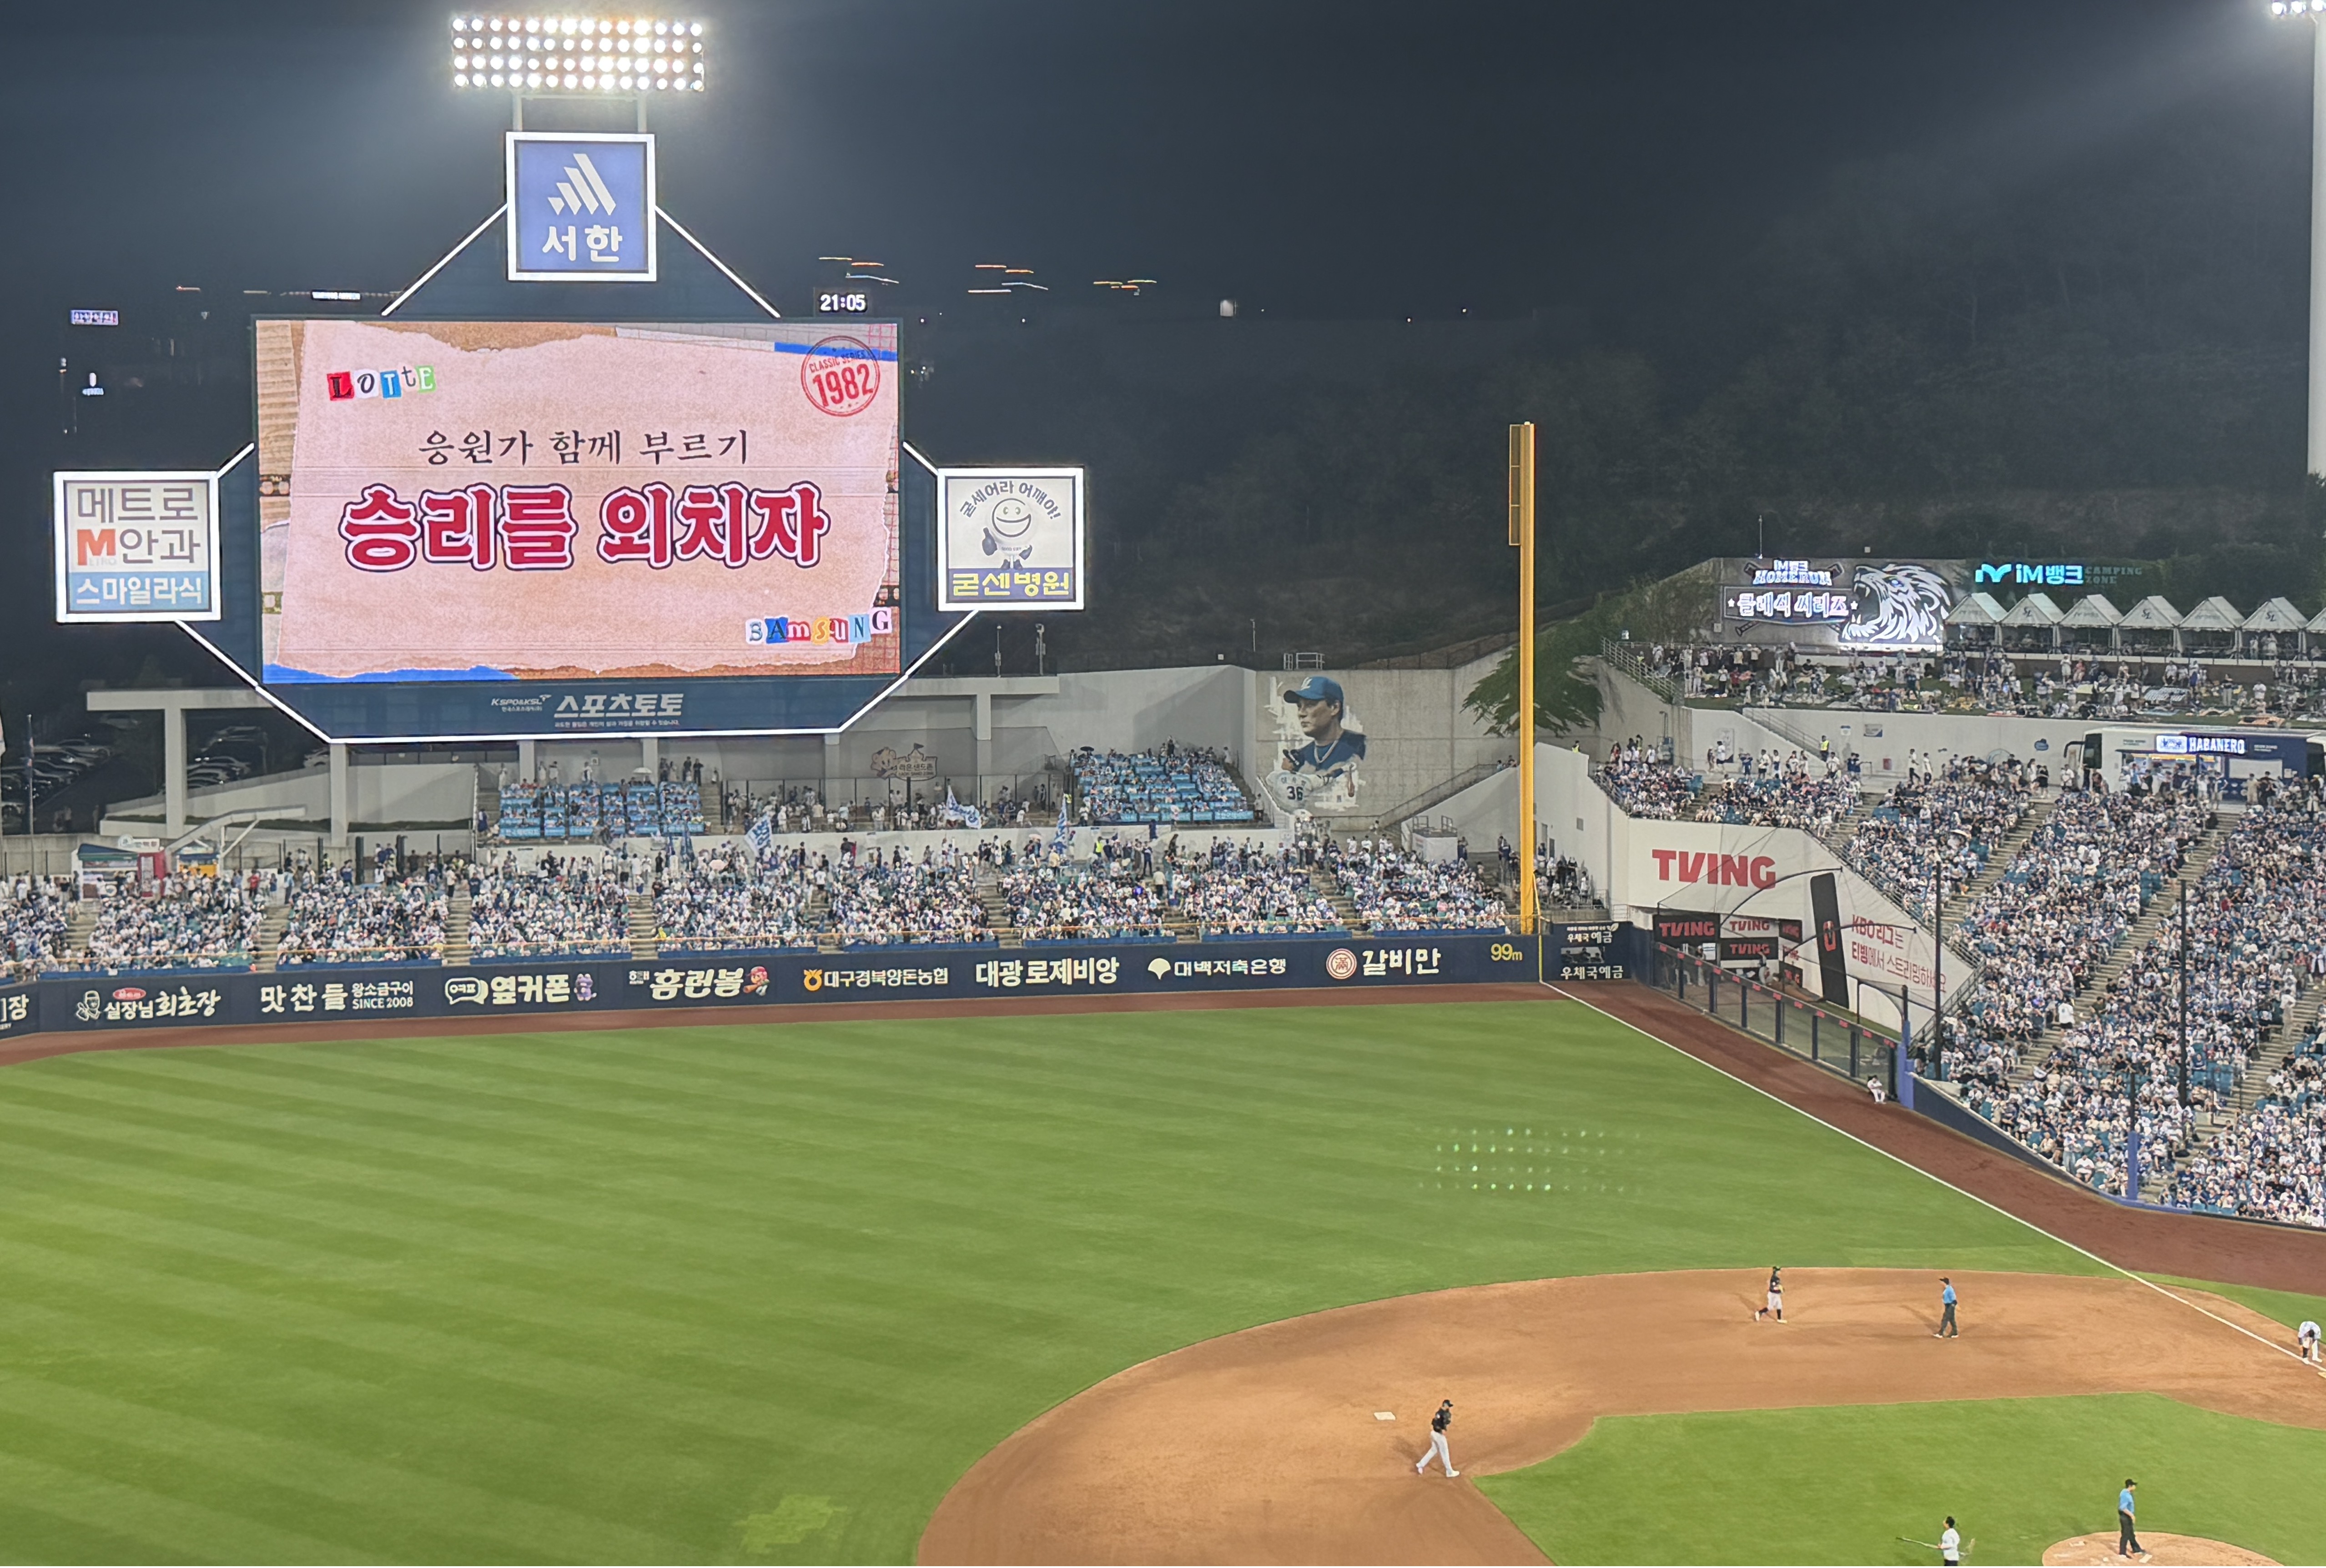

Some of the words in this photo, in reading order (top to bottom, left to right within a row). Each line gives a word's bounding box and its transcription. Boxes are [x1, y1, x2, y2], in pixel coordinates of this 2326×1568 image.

[542, 225, 623, 262] 서한
[820, 294, 866, 311] 21:05
[809, 357, 840, 373] CLASSIC
[813, 364, 873, 407] 1982
[418, 430, 534, 466] 응원가
[549, 429, 622, 465] 함께
[639, 428, 749, 465] 부르기
[77, 487, 198, 523] 메트로
[960, 480, 1014, 518] 굳세어라
[1018, 482, 1061, 520] 어깨야!
[338, 482, 578, 572] 승리를
[597, 481, 831, 569] 외치자
[120, 528, 201, 564] 안과
[953, 571, 1069, 597] 굳센병원
[1753, 569, 1833, 586] HOMERUN
[2016, 563, 2084, 584] iM뱅크
[2084, 566, 2142, 575] CAMPING
[2085, 576, 2117, 584] ZONE
[76, 576, 201, 605] 스마일라식
[1737, 592, 1791, 618] 클래식
[554, 694, 684, 718] 스포츠토토
[2189, 737, 2245, 754] HABANERO
[1287, 786, 1303, 800] 36
[1652, 849, 1776, 890] TVING
[1659, 921, 1715, 937] TVING
[1729, 920, 1770, 931] TVING
[1852, 915, 1904, 950] KBO리그는
[1567, 933, 1589, 943] 우체국
[1729, 944, 1770, 955] TVING
[1362, 948, 1441, 976] 갈비만
[1490, 943, 1523, 961] 99m
[824, 967, 948, 988] 대구경북양돈농협
[976, 960, 1023, 987] 대광
[1025, 957, 1120, 985] 로제비앙
[1174, 958, 1287, 976] 대백저축은행
[1561, 965, 1624, 980] 우체국예금
[352, 980, 413, 998] 왕소금구이
[491, 974, 570, 1005] 옆커폰
[649, 968, 744, 1000] 홈런볼
[0, 994, 30, 1021] 장
[104, 1000, 154, 1020] 실장님
[261, 983, 348, 1013] 맛찬들
[352, 997, 385, 1010] SINCE
[387, 996, 413, 1008] 2008
